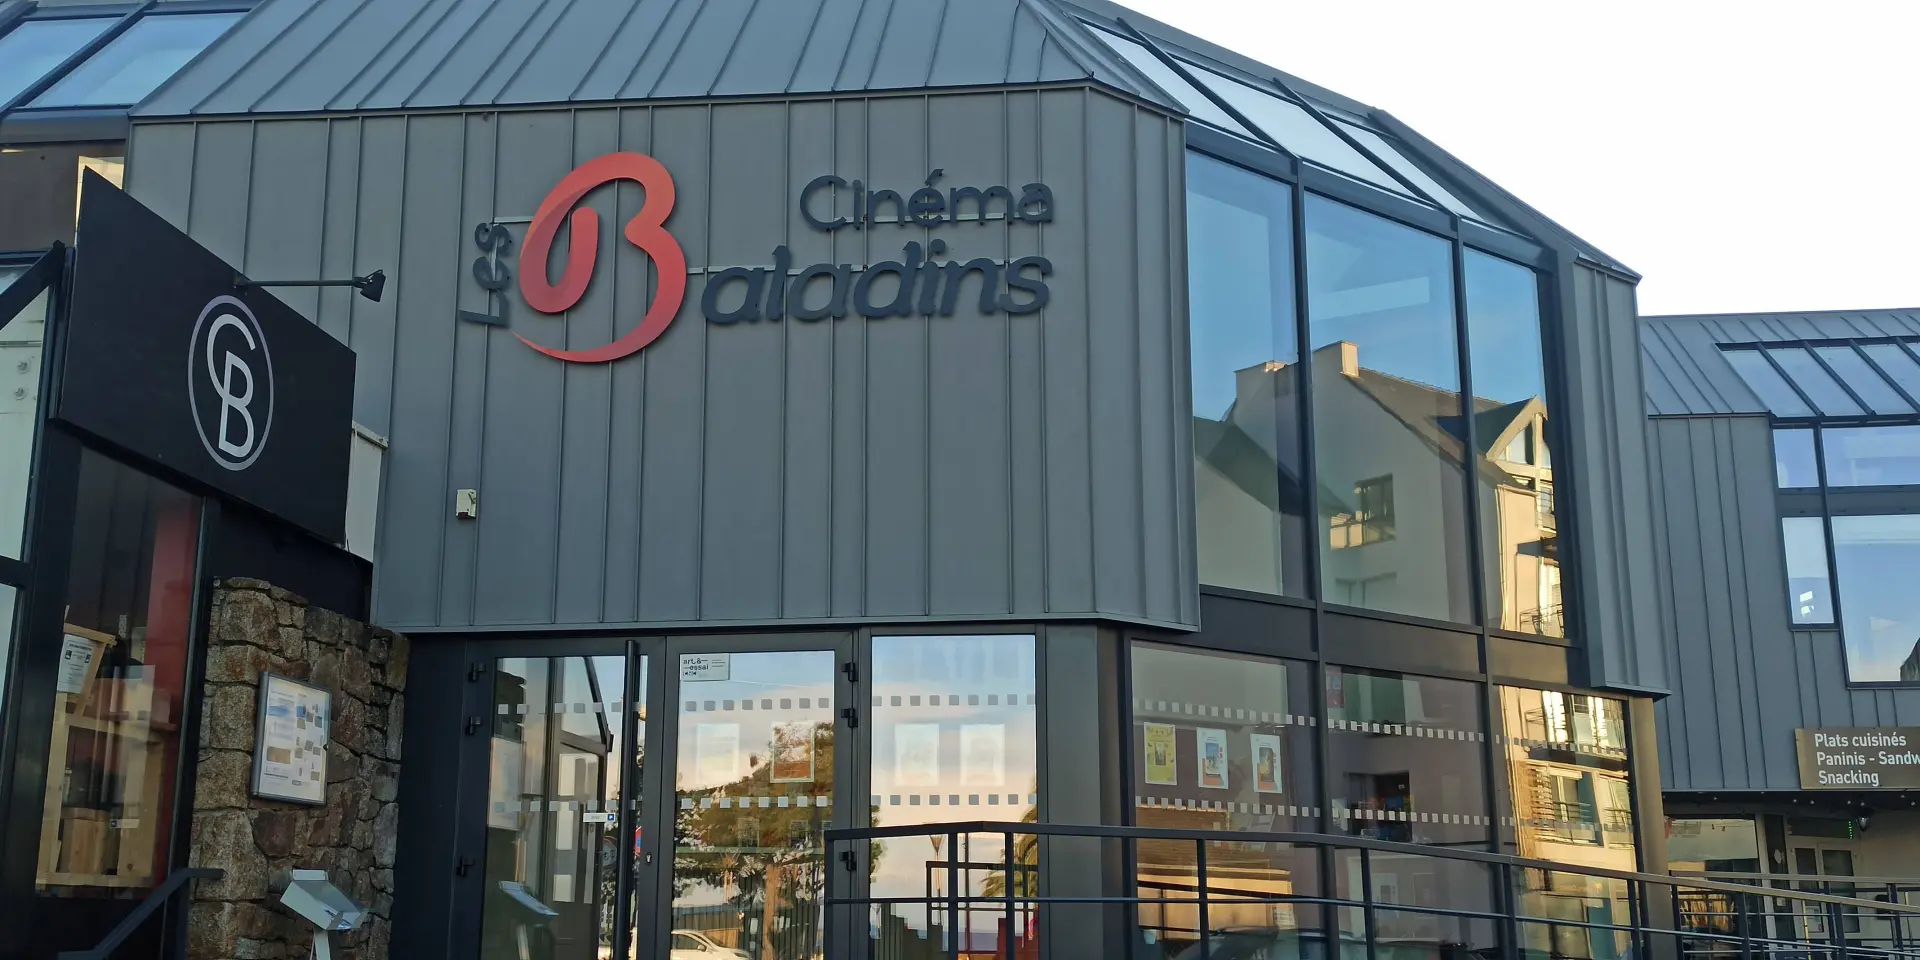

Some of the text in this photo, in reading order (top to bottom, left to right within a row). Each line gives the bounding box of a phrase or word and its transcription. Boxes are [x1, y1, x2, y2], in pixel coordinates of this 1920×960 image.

[799, 168, 1053, 232] Cinéma
[458, 222, 512, 328] Les
[1814, 731, 1907, 748] Plats cuisinés
[1816, 751, 1866, 766] Paninis
[1818, 769, 1880, 787] Snacking
